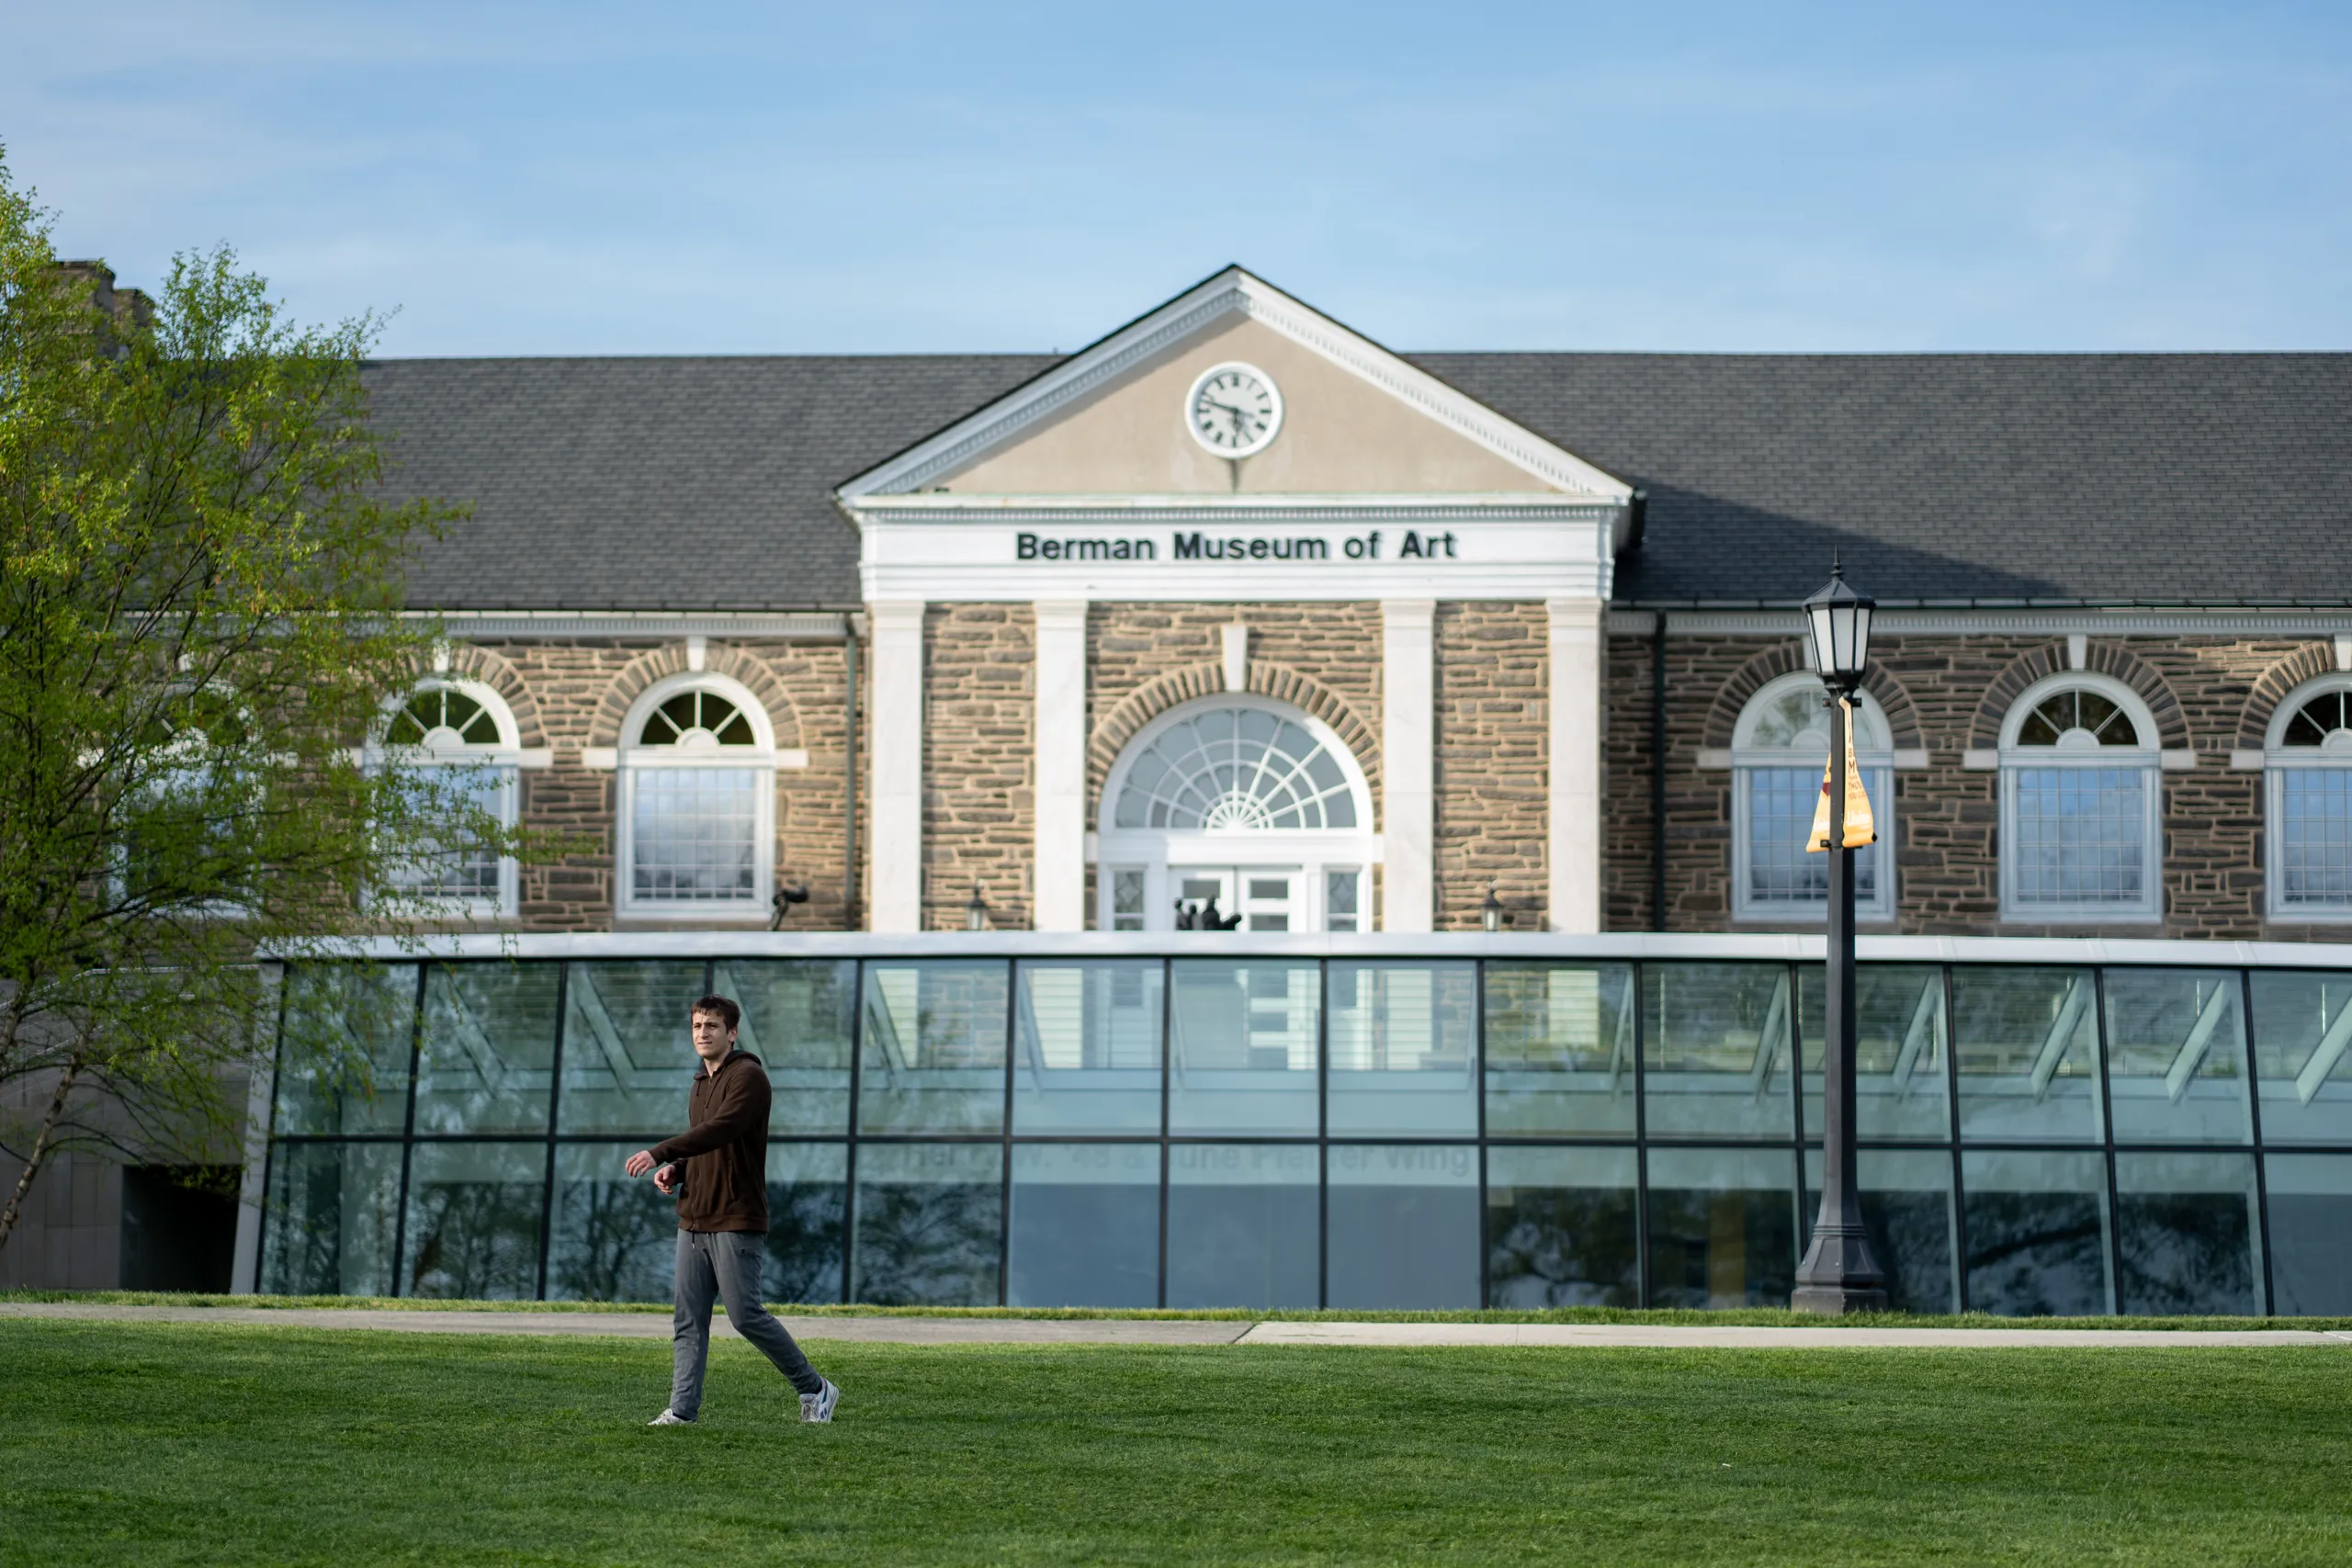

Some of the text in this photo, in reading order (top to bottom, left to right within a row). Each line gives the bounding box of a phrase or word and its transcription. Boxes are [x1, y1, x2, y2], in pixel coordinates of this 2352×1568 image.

[1016, 530, 1456, 560] Berman Museum of Art
